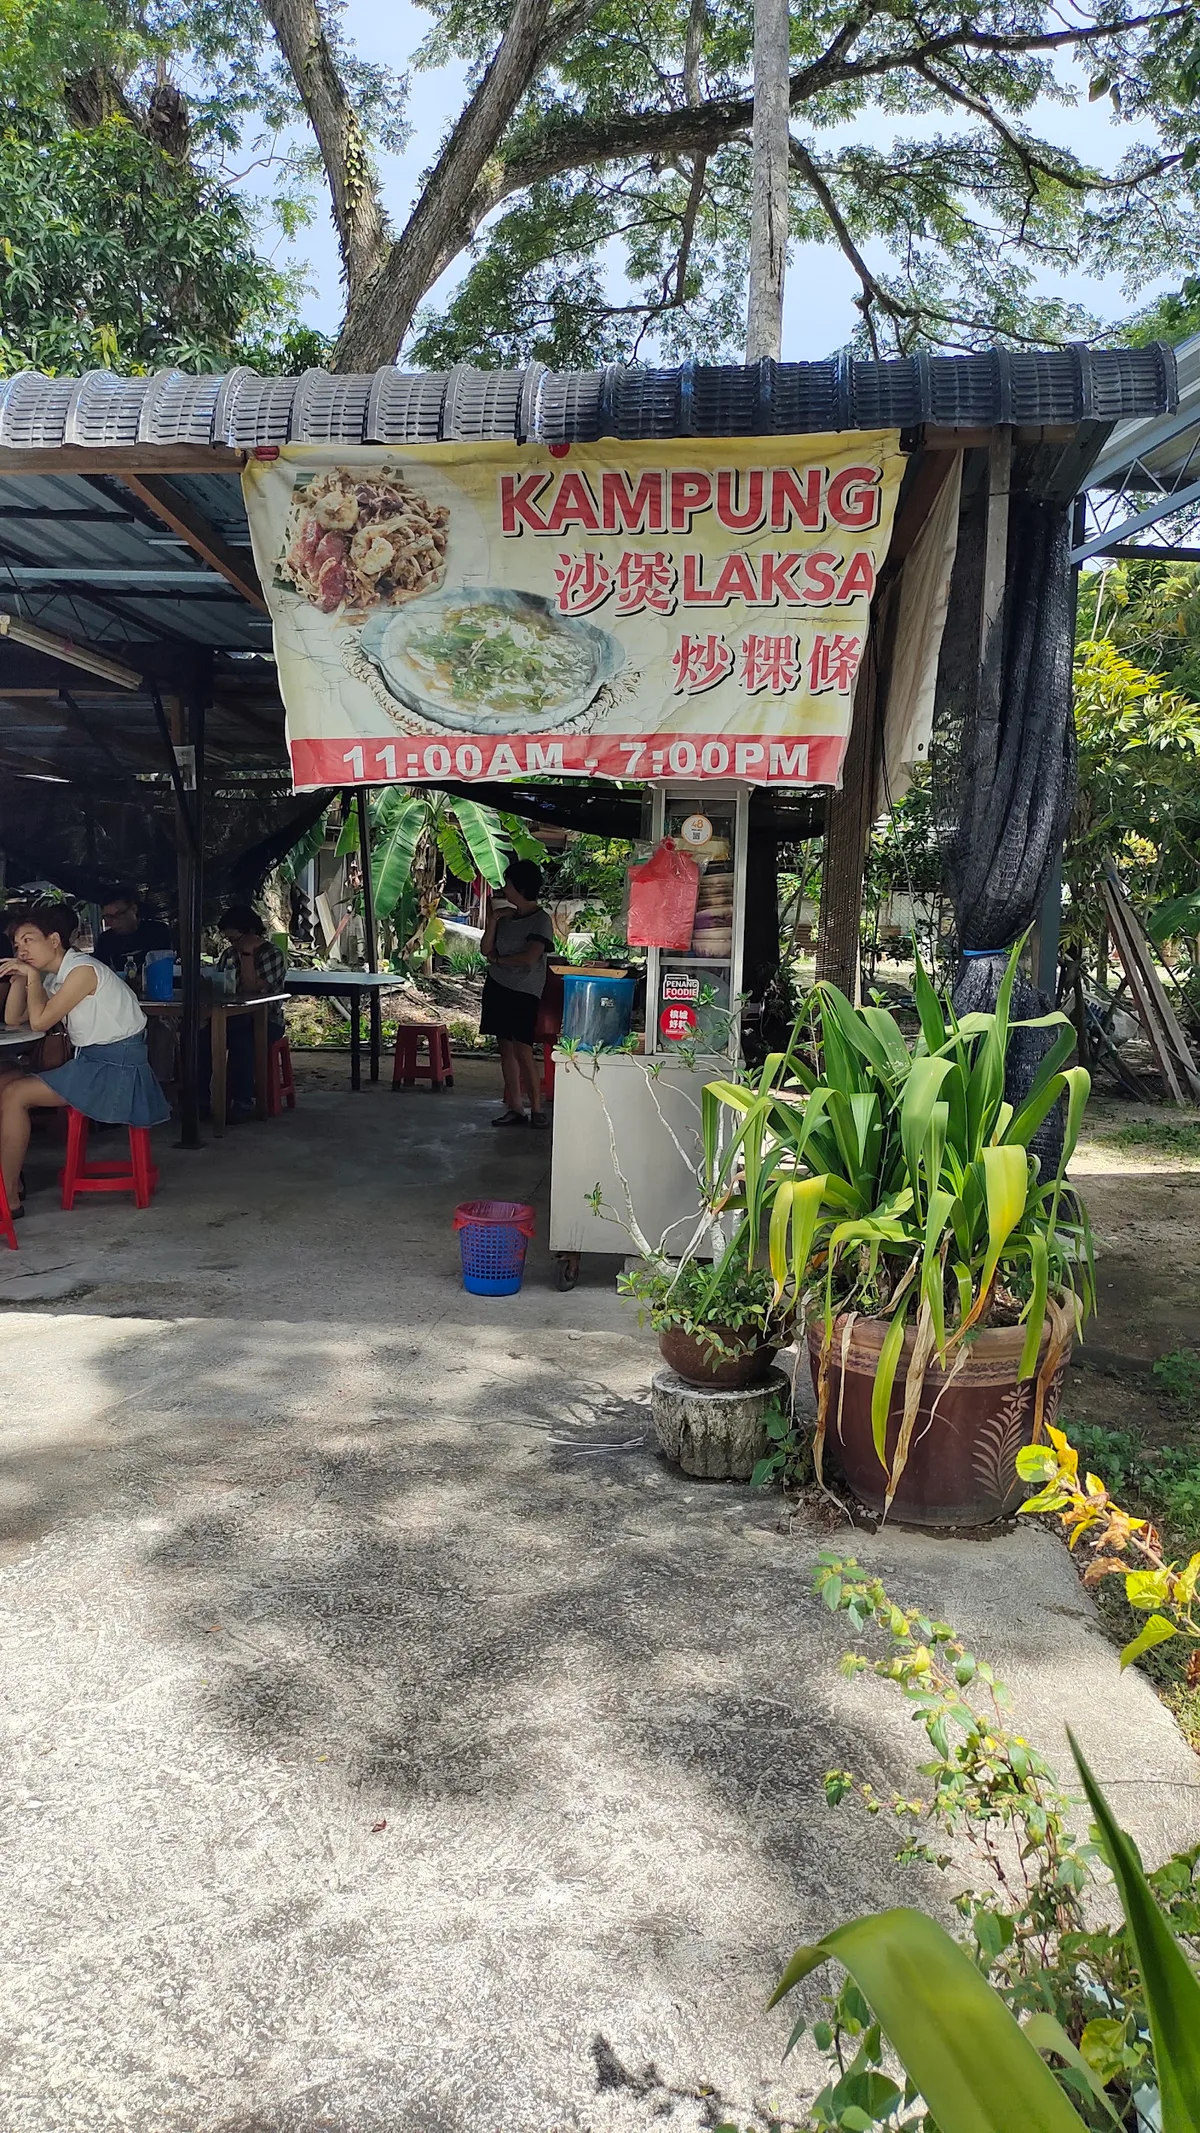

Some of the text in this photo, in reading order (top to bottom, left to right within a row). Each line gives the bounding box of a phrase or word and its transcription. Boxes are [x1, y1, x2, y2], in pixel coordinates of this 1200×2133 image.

[500, 465, 881, 535] KAMPUNG
[553, 550, 876, 613] 沙煲 LAKSA
[671, 633, 862, 692] 炒粿條
[342, 740, 810, 779] 11:00AM - 7:00PM
[665, 987, 698, 997] FOODIE
[666, 980, 698, 988] PENANG
